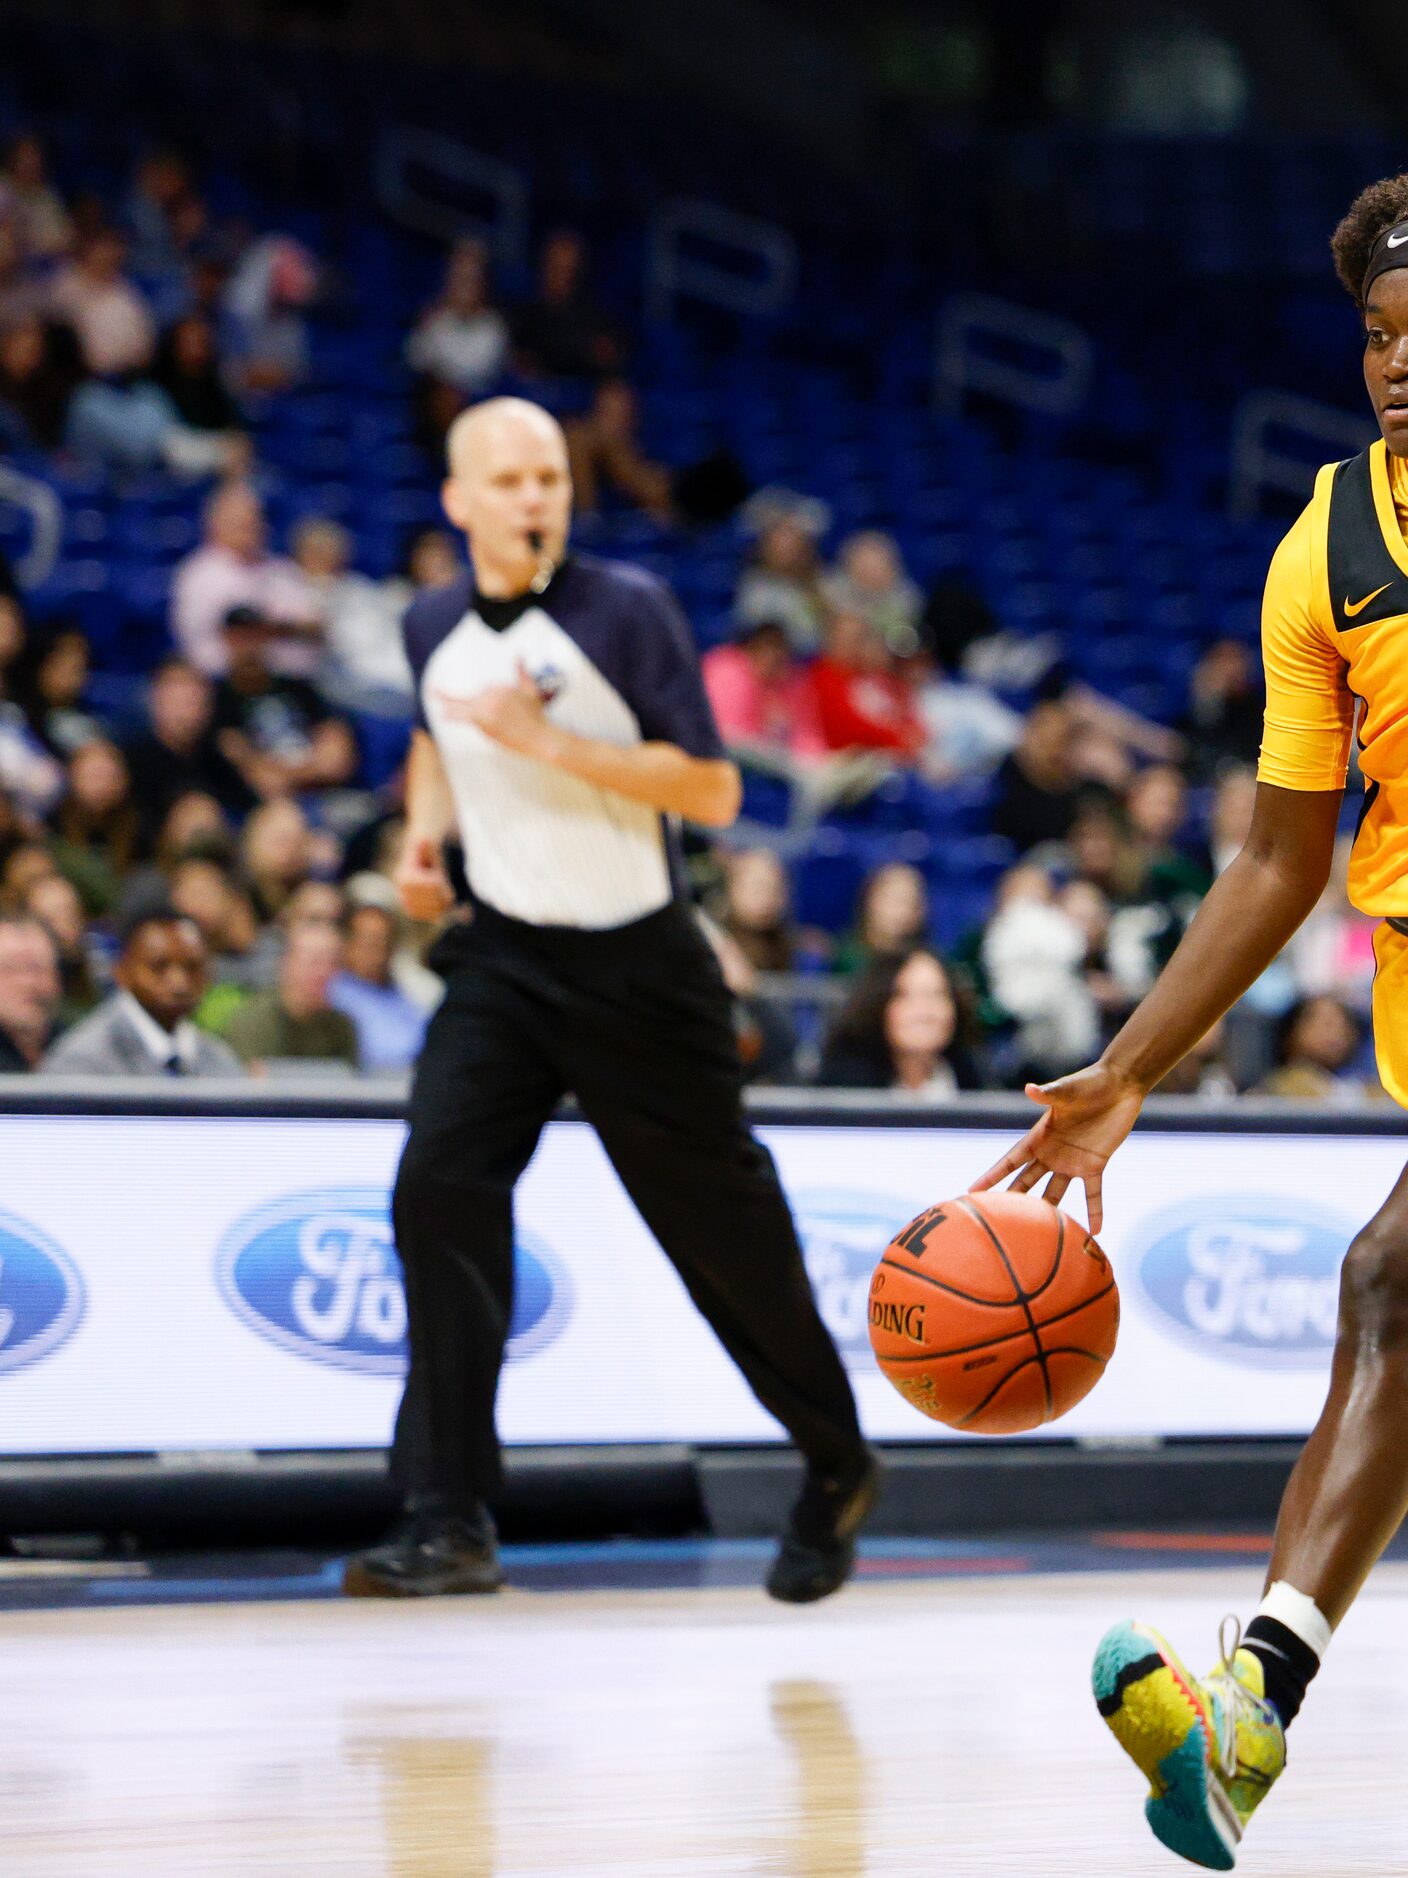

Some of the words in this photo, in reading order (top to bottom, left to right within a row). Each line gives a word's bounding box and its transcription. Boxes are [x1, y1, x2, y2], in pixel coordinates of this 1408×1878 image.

[292, 1216, 407, 1342] Fo
[870, 1301, 926, 1342] DING
[1183, 1222, 1341, 1341] For
